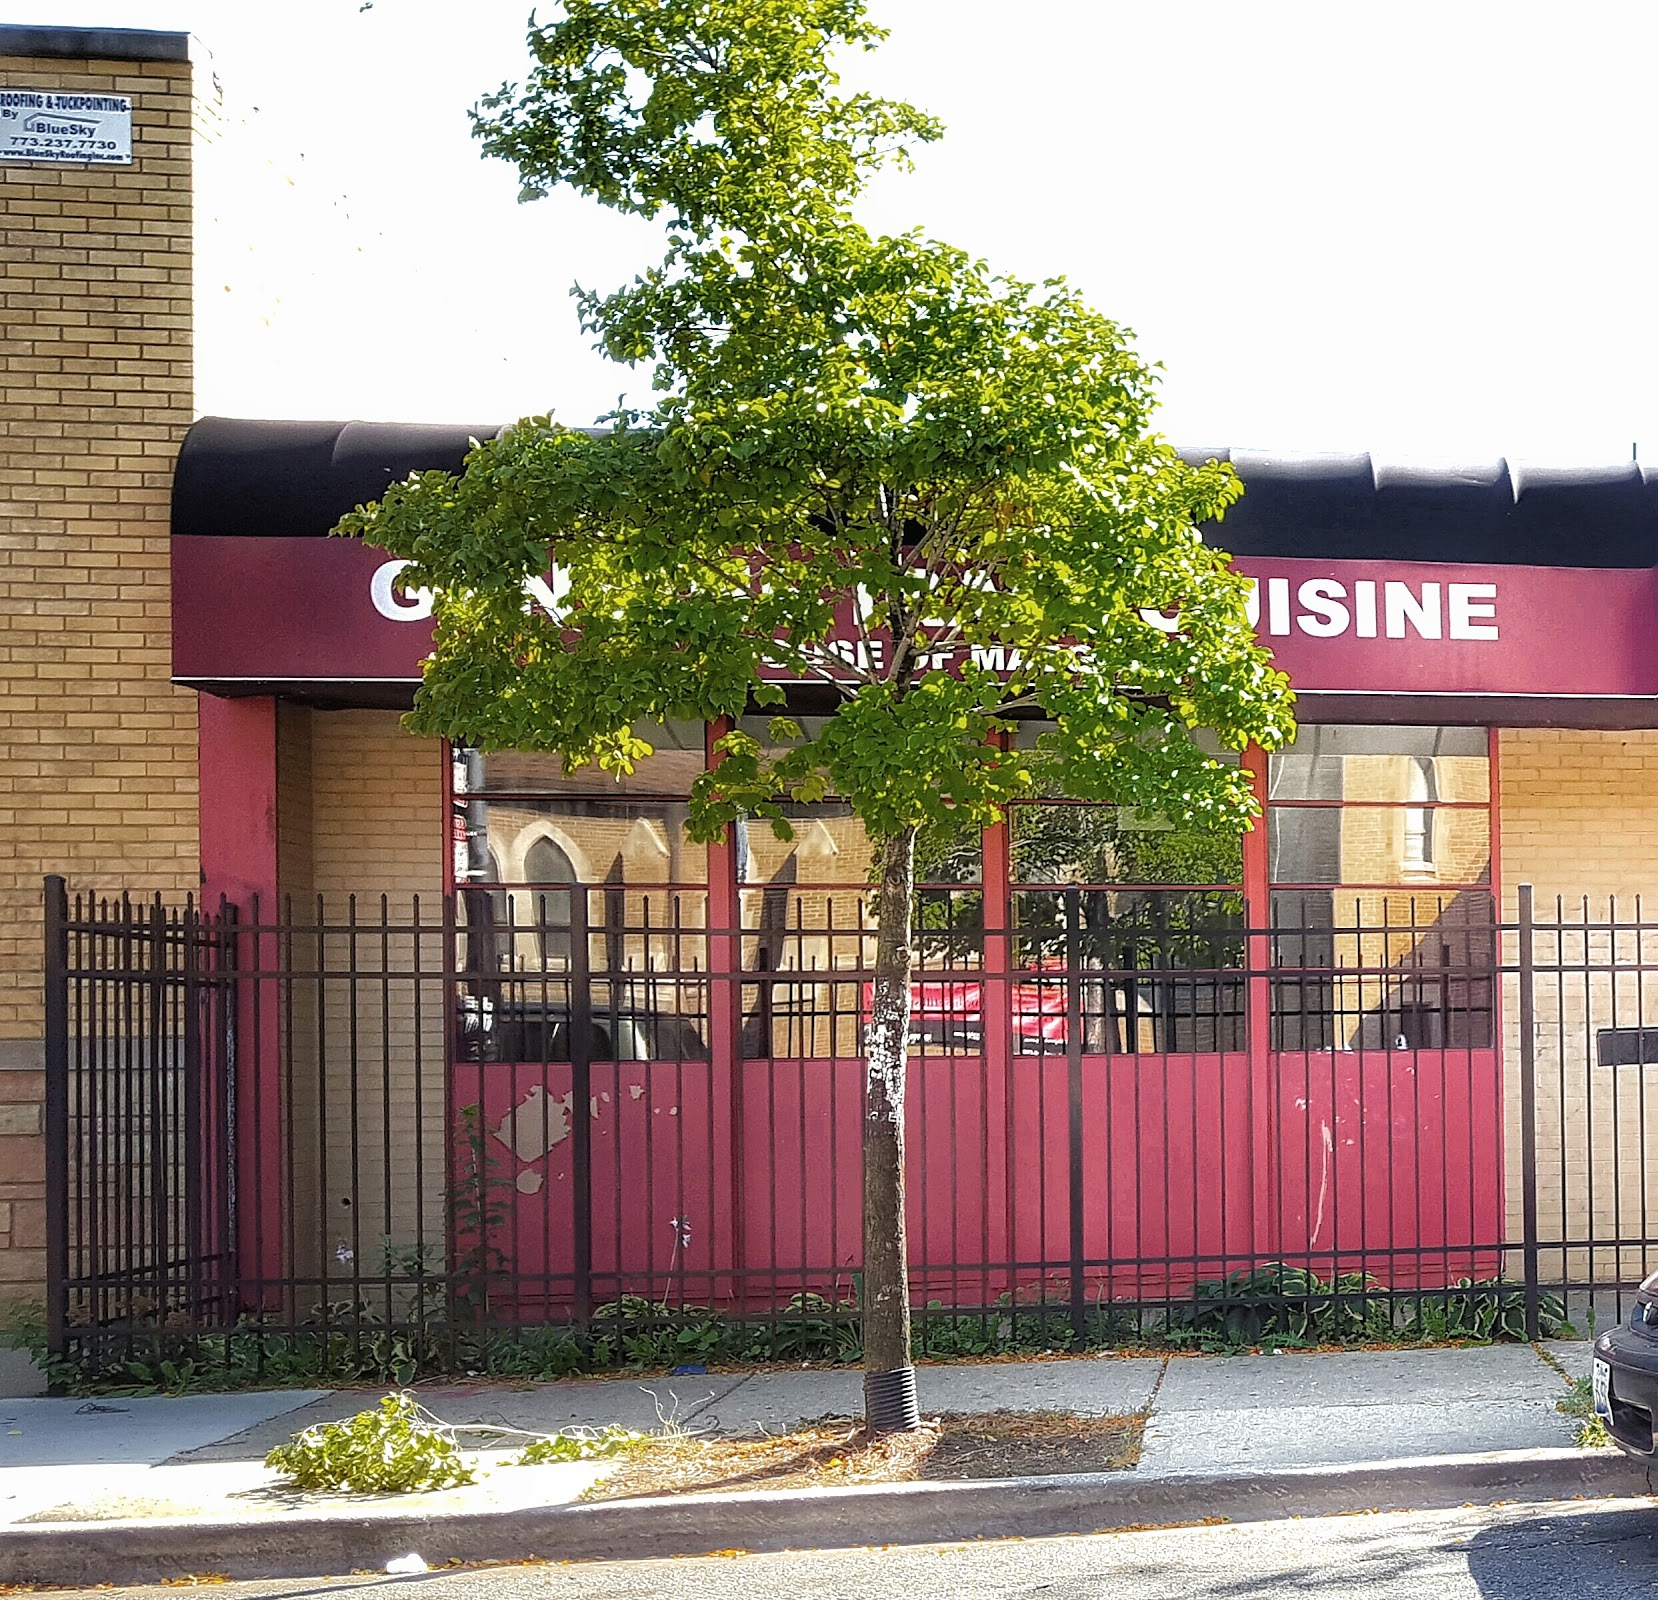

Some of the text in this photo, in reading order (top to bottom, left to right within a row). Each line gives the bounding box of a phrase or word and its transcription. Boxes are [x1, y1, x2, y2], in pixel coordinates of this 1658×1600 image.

[0, 93, 130, 112] ROOFING & TUCKPOINTING
[3, 109, 18, 120] By
[36, 123, 96, 138] BlueSky
[10, 136, 117, 150] 773.237.7730
